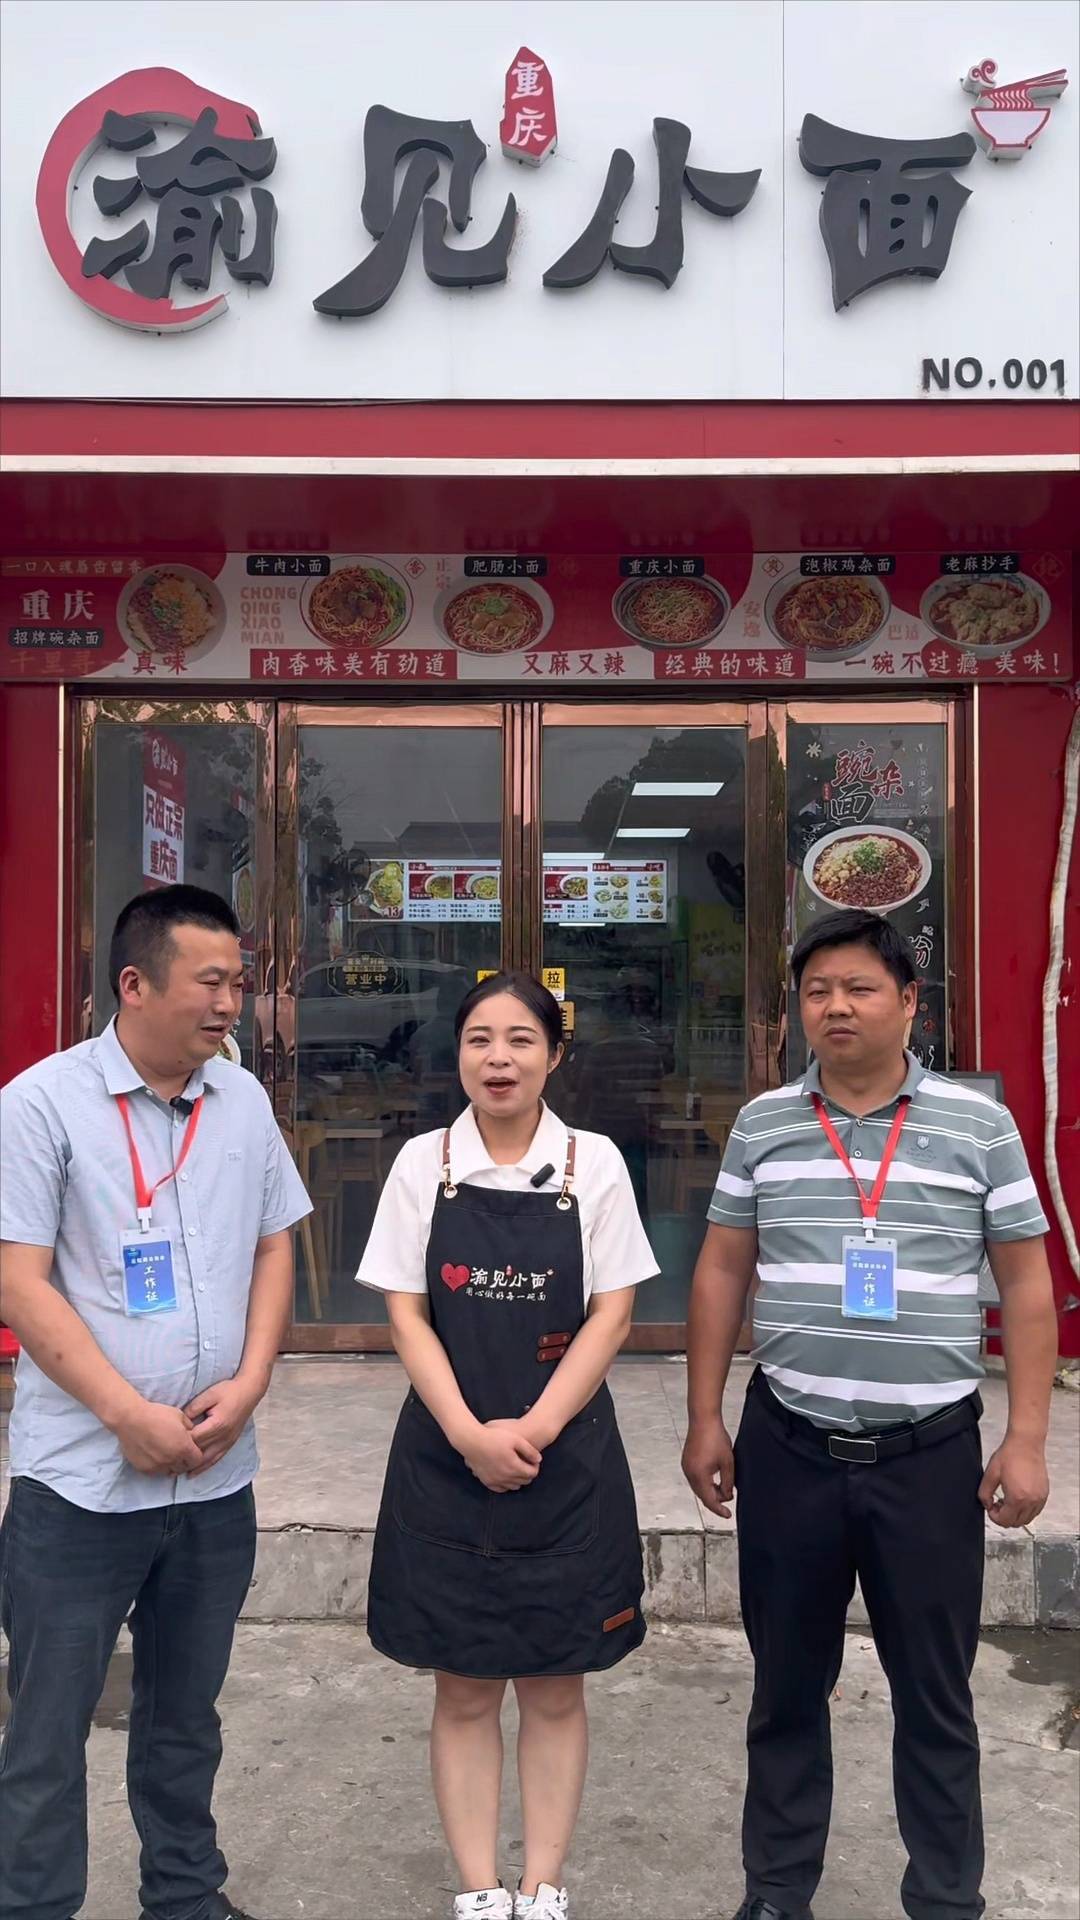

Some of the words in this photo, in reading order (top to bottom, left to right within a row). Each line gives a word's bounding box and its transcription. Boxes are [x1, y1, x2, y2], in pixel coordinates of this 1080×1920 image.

[508, 60, 549, 146] 重庆
[82, 104, 977, 317] 渝见小面
[922, 357, 1067, 391] NO.001
[255, 557, 323, 574] 牛肉小面
[471, 559, 540, 575] 肥肠小面
[628, 559, 696, 575] 重庆小面
[805, 556, 891, 573] 泡椒鸡杂面
[945, 555, 1016, 572] 老麻抄手
[240, 586, 297, 600] CHONG
[19, 588, 95, 622] 重庆
[240, 602, 282, 616] QING
[240, 617, 282, 630] XIAO
[13, 628, 100, 646] 招牌碗杂面
[240, 631, 285, 645] MIAN
[262, 652, 446, 677] 肉香味美有劲道
[522, 651, 626, 676] 又麻又辣
[664, 652, 796, 678] 经典的味道
[845, 650, 979, 676] 一碗不过瘾
[145, 789, 184, 842] 只做正宗
[150, 838, 178, 882] 重庆面
[345, 973, 387, 986] 营业中
[547, 970, 561, 984] 拉
[144, 1266, 159, 1302] 工作证
[470, 1267, 547, 1289] 渝见小面
[466, 1287, 547, 1302] 用心做好每一碗面
[863, 1272, 877, 1307] 工作证
